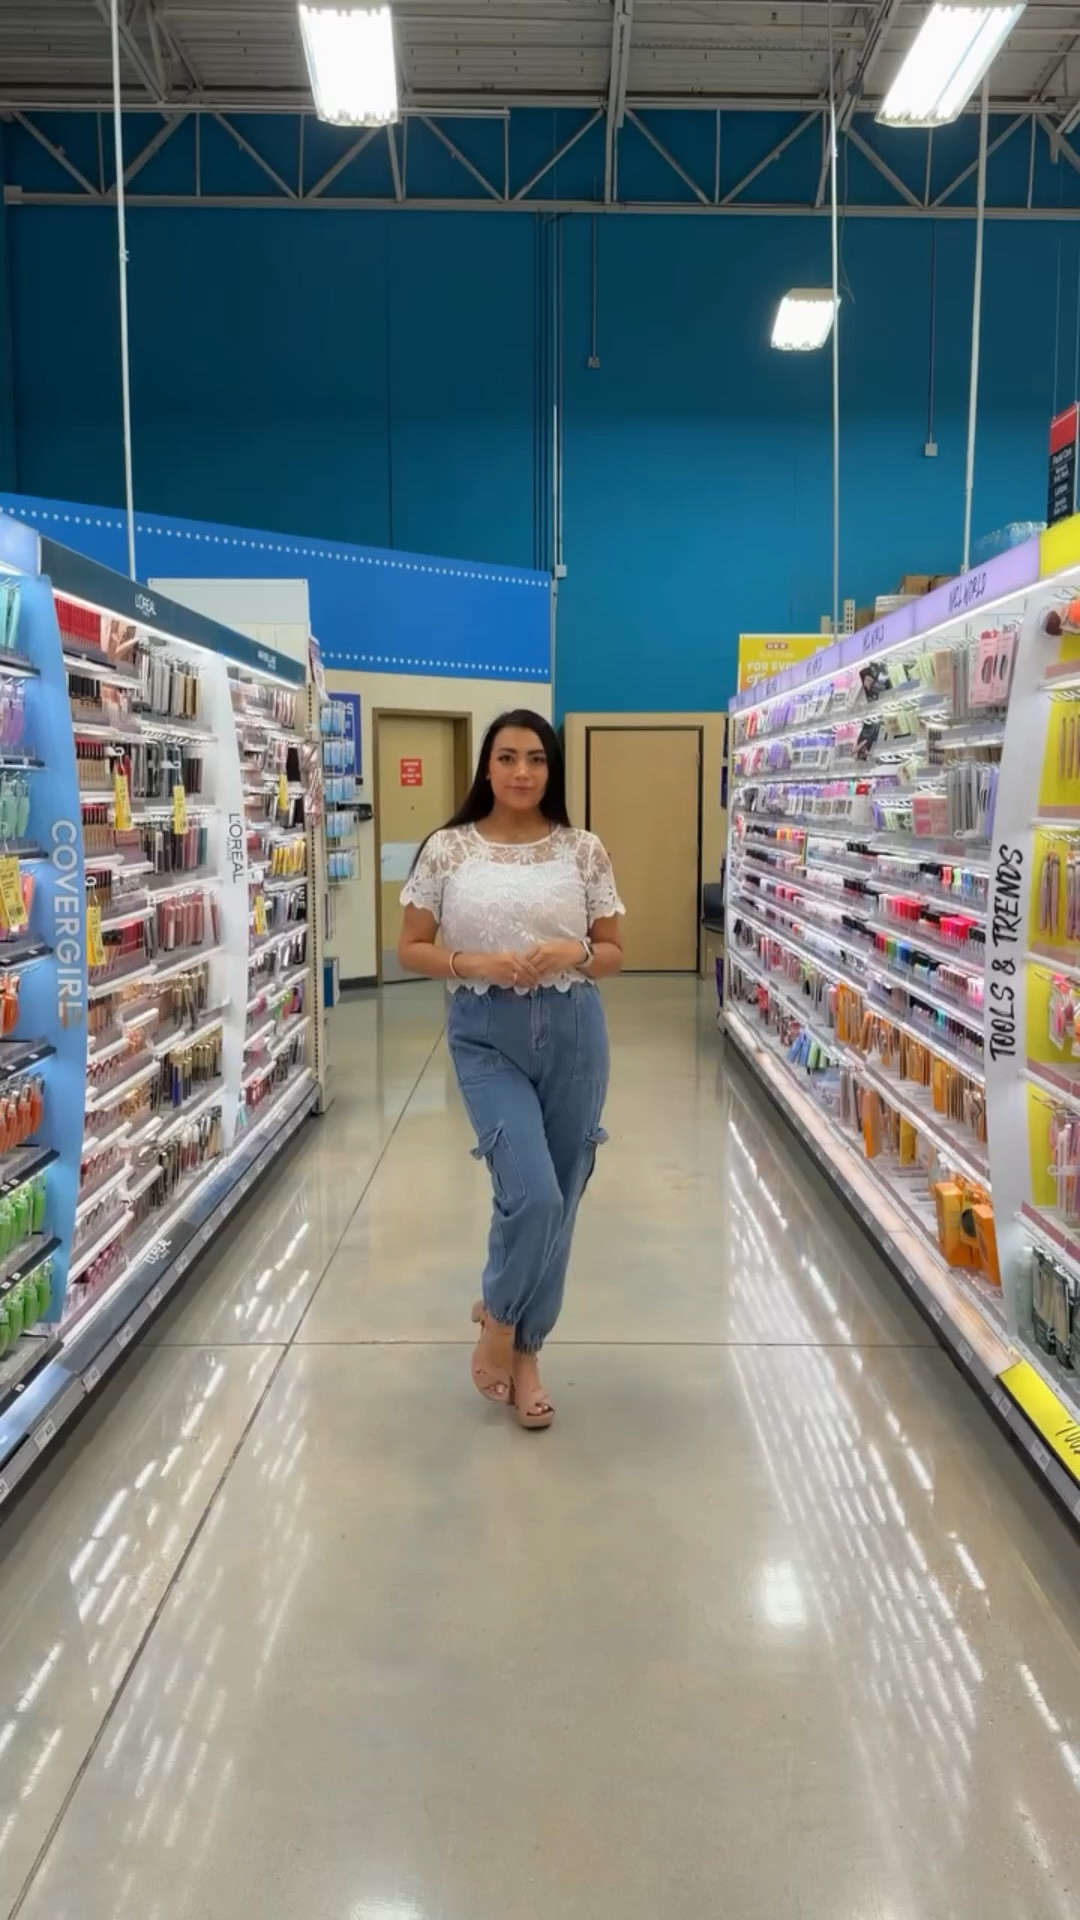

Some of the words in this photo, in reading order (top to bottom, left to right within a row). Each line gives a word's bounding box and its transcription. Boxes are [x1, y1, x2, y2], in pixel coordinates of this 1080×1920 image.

[746, 662, 768, 672] FOR
[229, 813, 244, 884] L'OREAL
[51, 819, 83, 1018] COVERGIRL
[991, 844, 1023, 948] TRENDS
[991, 957, 1016, 976] &
[990, 982, 1016, 1062] TOOLS
